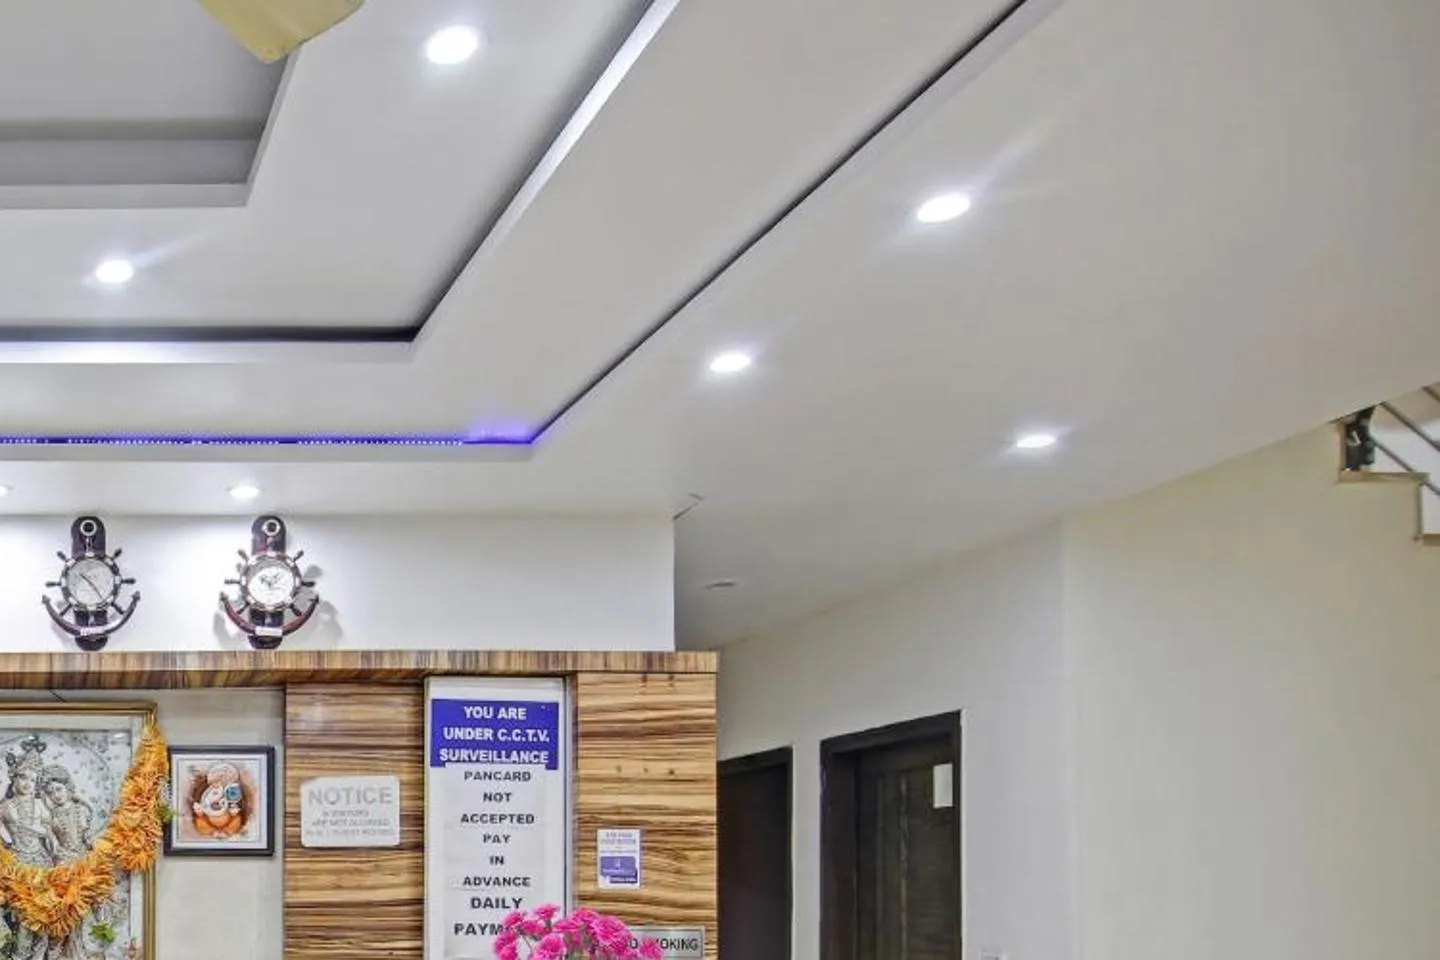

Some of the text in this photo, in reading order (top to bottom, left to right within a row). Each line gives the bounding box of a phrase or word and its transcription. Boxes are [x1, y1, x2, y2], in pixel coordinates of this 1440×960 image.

[464, 706, 527, 720] YOU ARE
[443, 727, 550, 742] UNDER C.C.T.V.
[440, 748, 549, 764] SURVEILLANCE
[464, 771, 531, 782] PANCARD
[308, 786, 393, 806] NOTICE
[483, 791, 512, 803] NOT
[460, 813, 535, 824] ACCEPTED
[483, 834, 511, 843] PAY
[490, 856, 504, 866] IN
[463, 876, 531, 887] ADVANCE
[471, 897, 522, 909] DAILY
[454, 923, 516, 936] PAYM
[647, 938, 699, 951] OKING
